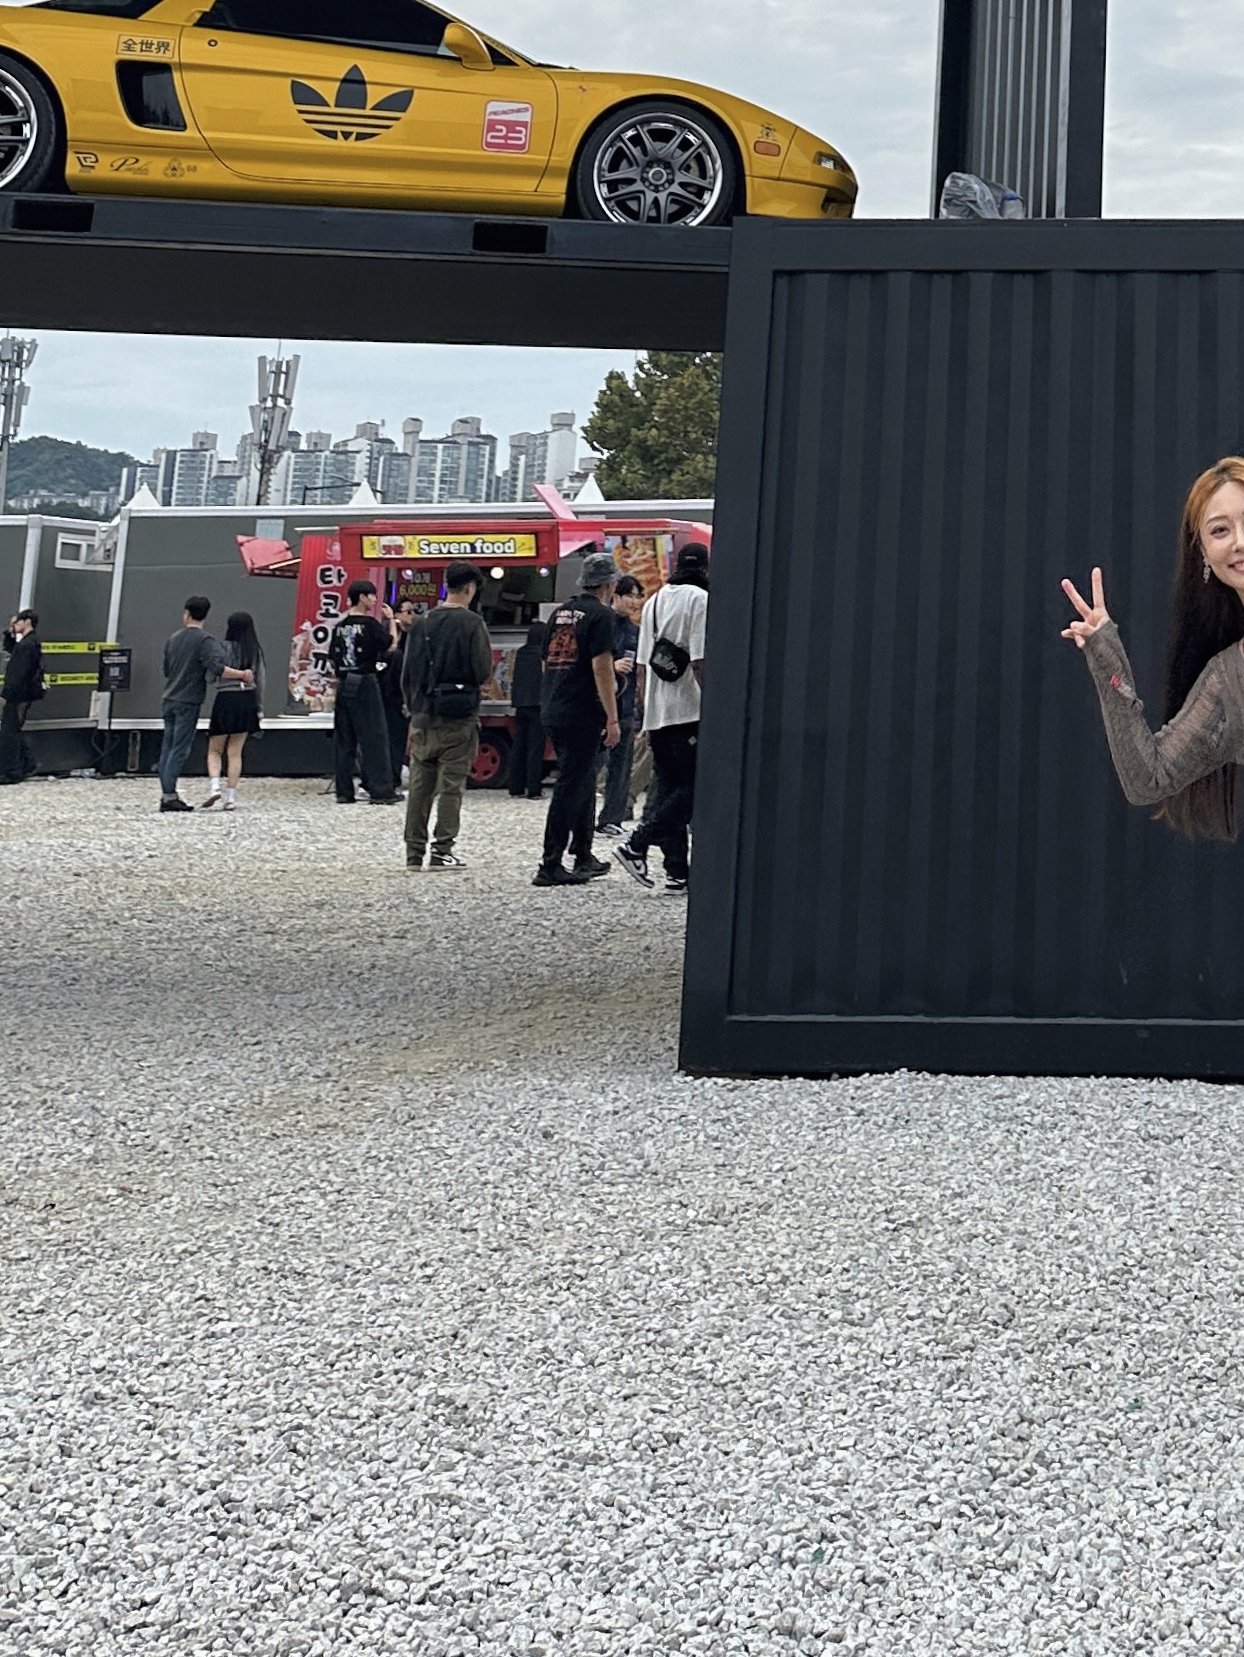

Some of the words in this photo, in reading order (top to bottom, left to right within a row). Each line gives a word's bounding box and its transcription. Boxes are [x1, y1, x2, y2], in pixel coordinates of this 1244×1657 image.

[121, 38, 171, 54] 全世界
[486, 125, 526, 144] 23
[419, 539, 472, 555] Seven
[475, 538, 515, 555] food
